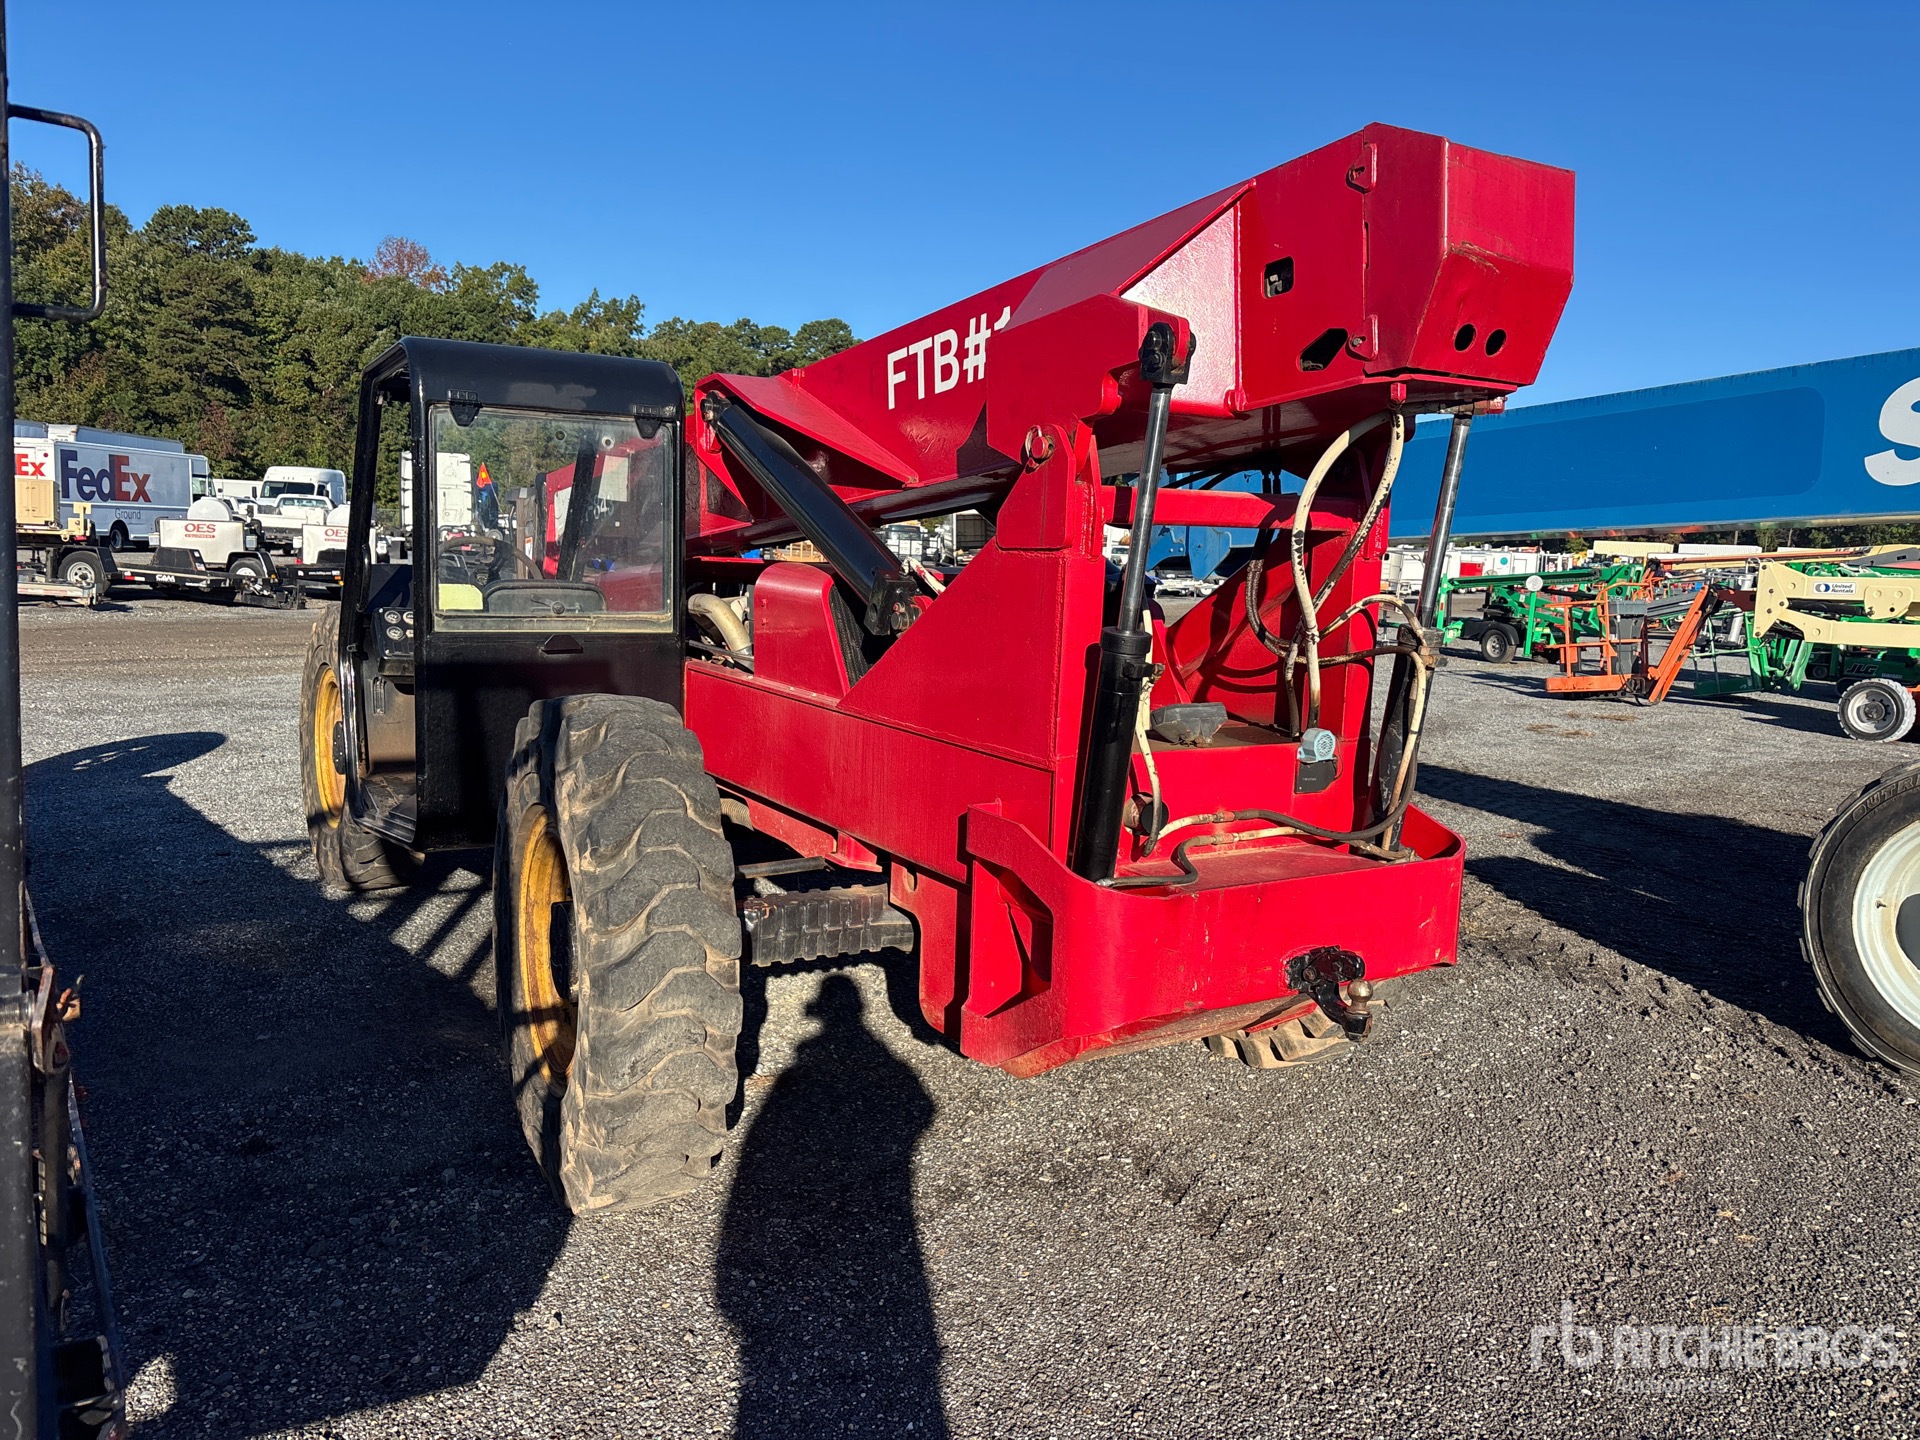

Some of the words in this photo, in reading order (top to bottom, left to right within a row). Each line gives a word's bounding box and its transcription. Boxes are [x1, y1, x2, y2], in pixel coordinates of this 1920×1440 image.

[60, 448, 152, 503] FedEx
[114, 507, 141, 520] Ground
[184, 523, 216, 533] OES
[1845, 662, 1879, 676] JLG
